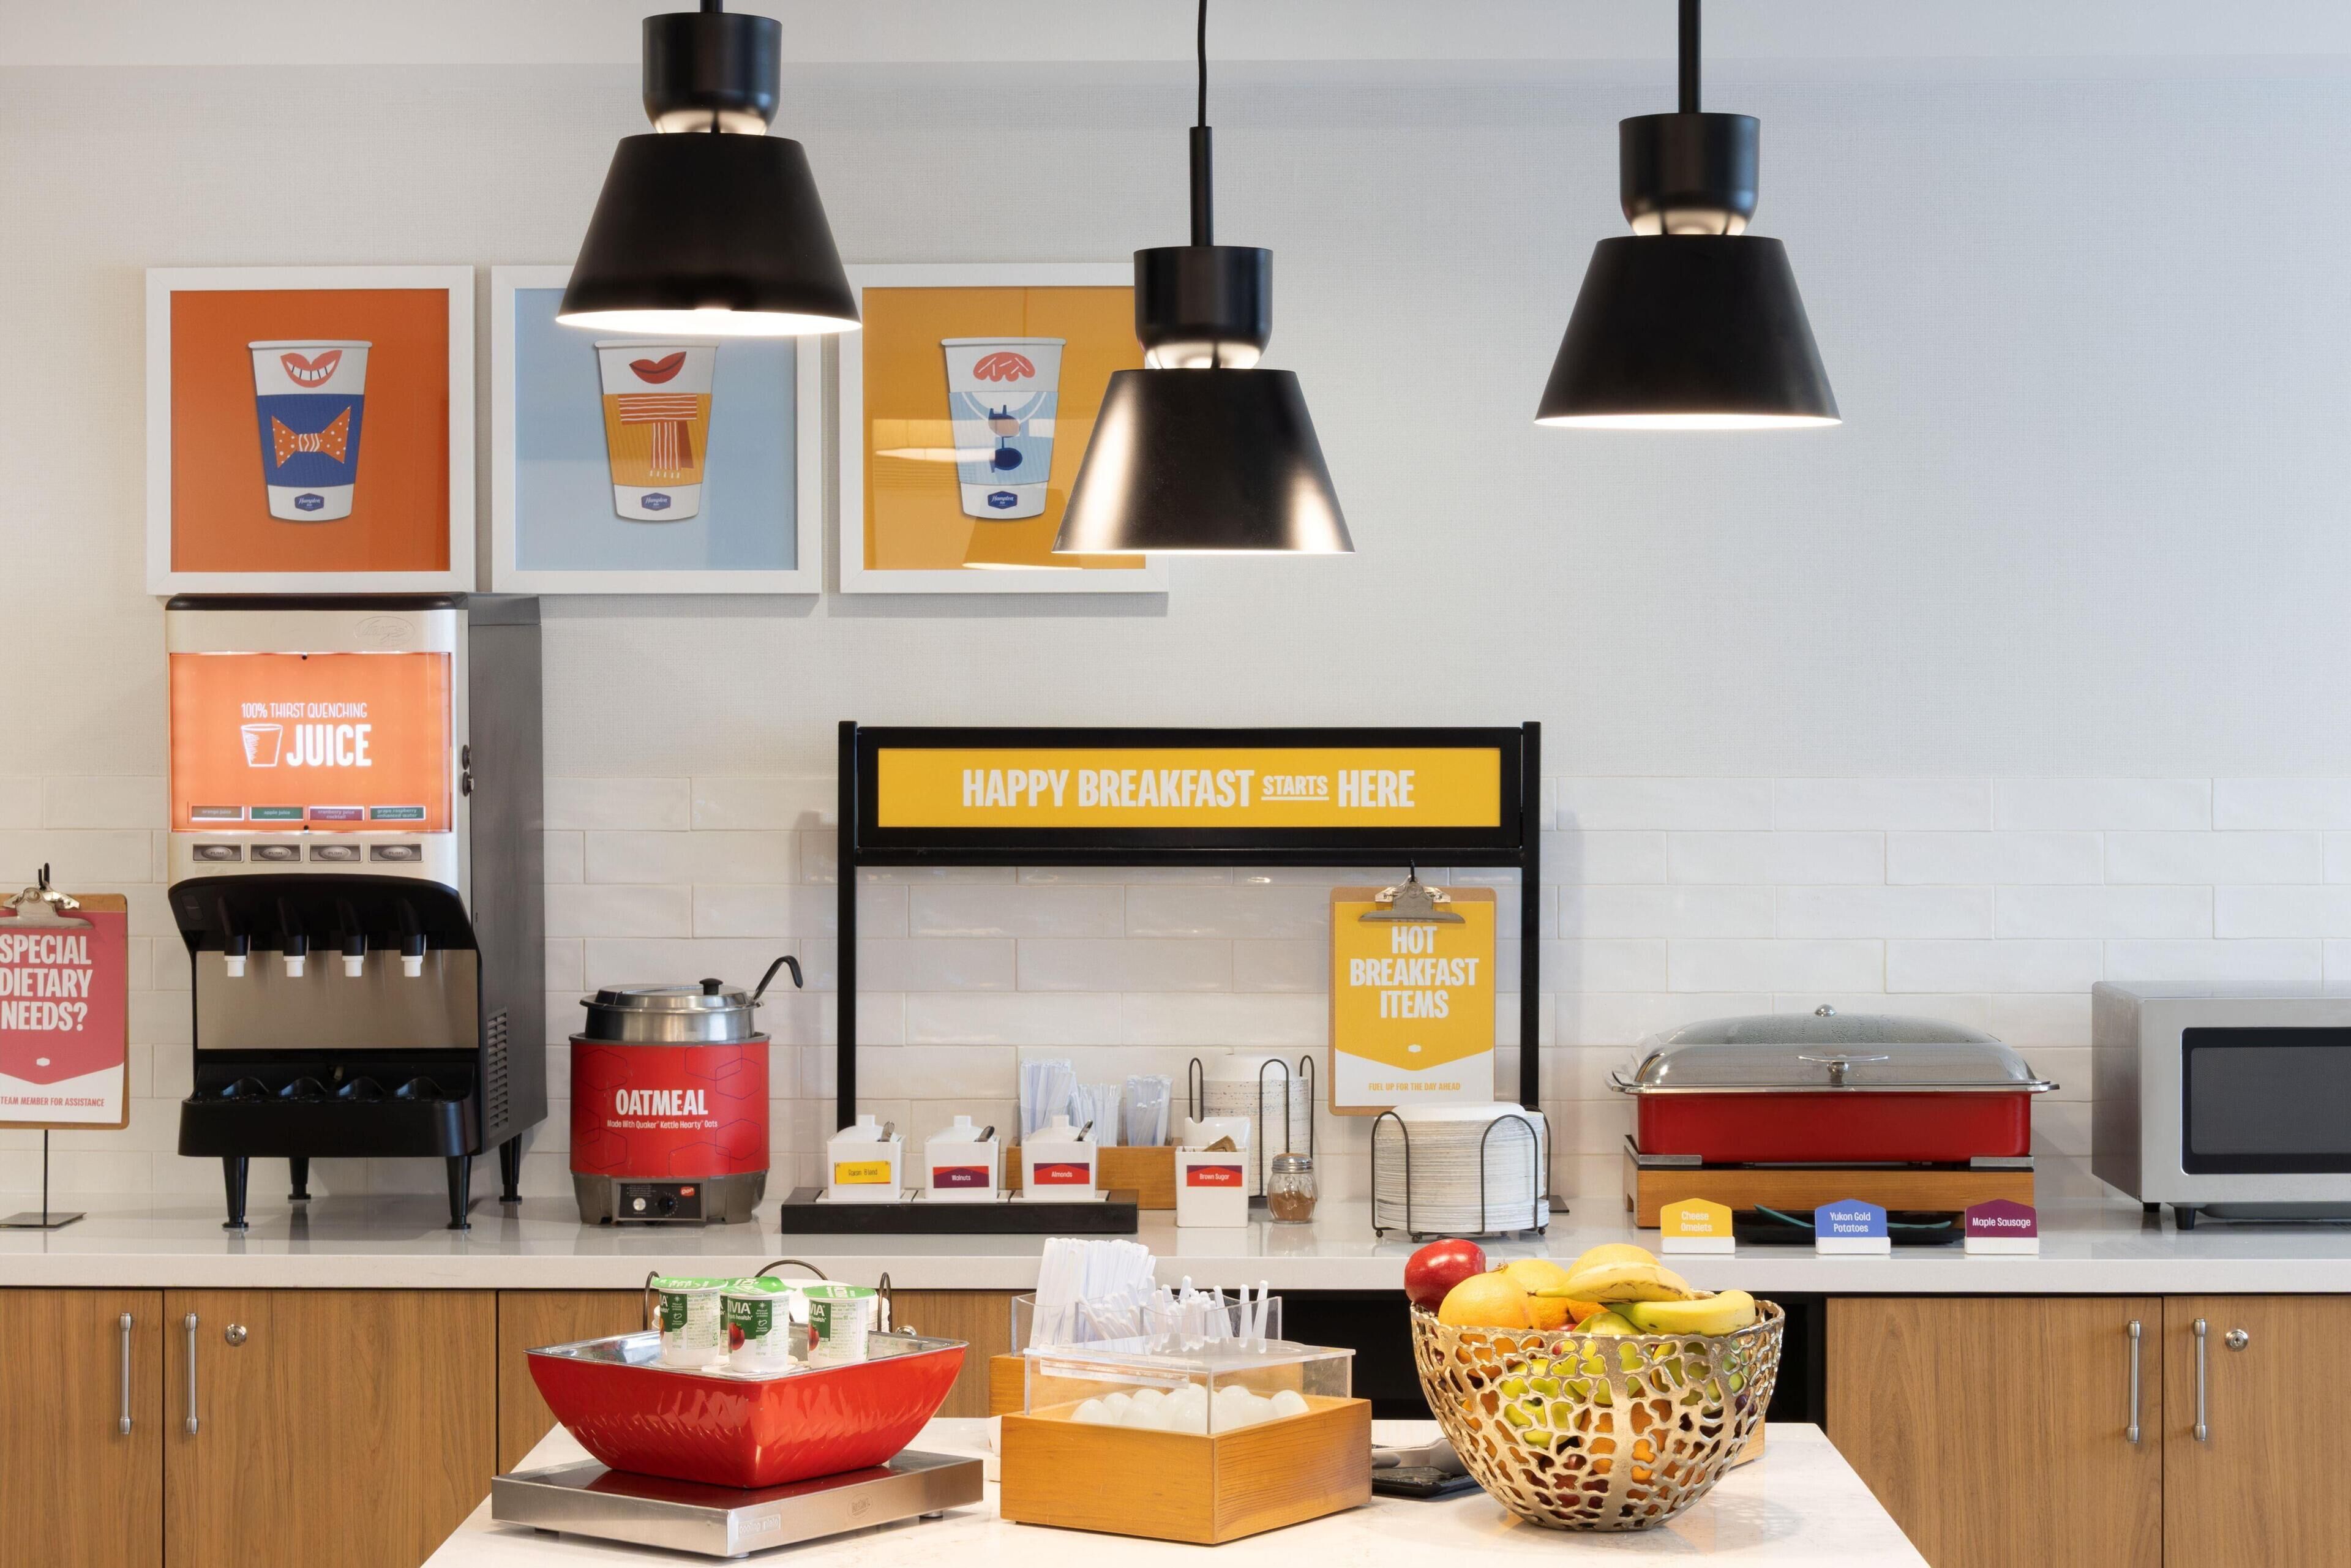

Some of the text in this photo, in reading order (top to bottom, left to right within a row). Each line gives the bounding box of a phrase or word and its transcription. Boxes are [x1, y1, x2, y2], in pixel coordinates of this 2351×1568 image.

[241, 703, 367, 718] 100% THIRST QUENCHING
[287, 724, 372, 767] JUICE
[963, 769, 1415, 808] HAPPY BREAKFAST STARTS HERE
[0, 934, 92, 964] SPECIAL
[1392, 926, 1437, 954] HOT
[0, 967, 93, 997] DIETARY
[1350, 958, 1479, 986] BREAKFAST
[1381, 989, 1449, 1018] ITEMS
[1, 1000, 88, 1031] NEEDS?
[1369, 1082, 1383, 1091] FUEL
[1, 1096, 105, 1107] TEAM MEMBER FOR ASSISTANCE
[615, 1089, 708, 1116] OATMEAL
[607, 1119, 621, 1128] Made
[622, 1120, 635, 1128] With
[660, 1120, 679, 1129] Kettle
[1681, 1211, 1709, 1220] Cheese
[1830, 1212, 1871, 1221] Yukon Gold
[1973, 1217, 2031, 1228] Maple Sausage
[1681, 1223, 1712, 1231] Omelets
[1834, 1224, 1869, 1232] Potatoes
